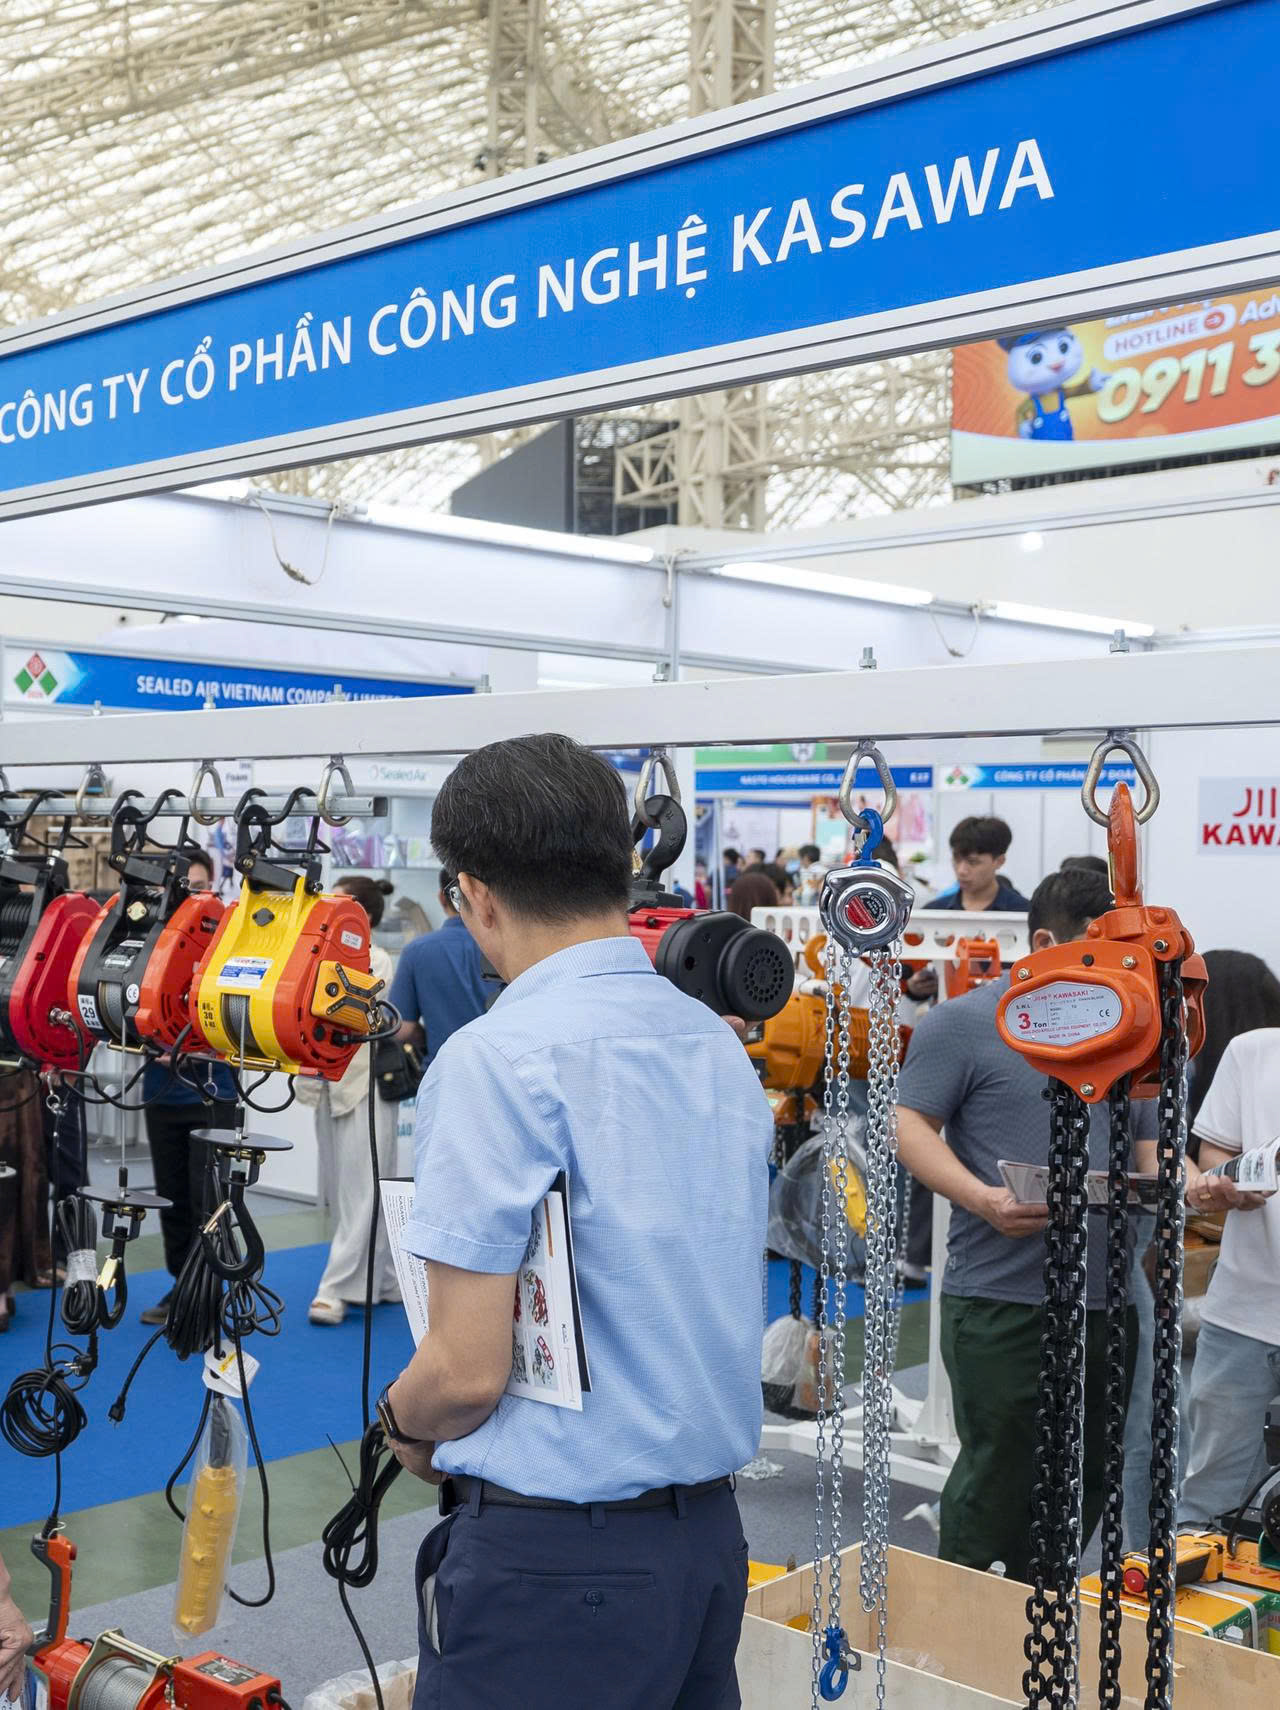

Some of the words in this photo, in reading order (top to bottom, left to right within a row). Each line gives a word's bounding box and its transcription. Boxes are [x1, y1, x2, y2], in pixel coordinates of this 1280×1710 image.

[102, 368, 150, 421] TY
[160, 336, 216, 405] CỔ
[228, 312, 352, 392] PHẦN
[368, 275, 518, 356] CÔNG
[537, 213, 708, 319] NGHỆ
[733, 138, 1056, 273] KASAWA
[1114, 317, 1199, 353] HOTLINE
[1239, 295, 1280, 326] Ad
[1097, 341, 1234, 424] 0911
[136, 675, 193, 697] SEALED
[195, 680, 217, 699] AIR
[221, 682, 285, 704] VIETNAM
[286, 688, 352, 704] COMPAY
[1202, 823, 1280, 846] KAW
[1053, 990, 1088, 999] KAWASAKI
[82, 1006, 95, 1018] 29
[1018, 1013, 1031, 1030] 3
[1099, 1008, 1110, 1018] CE
